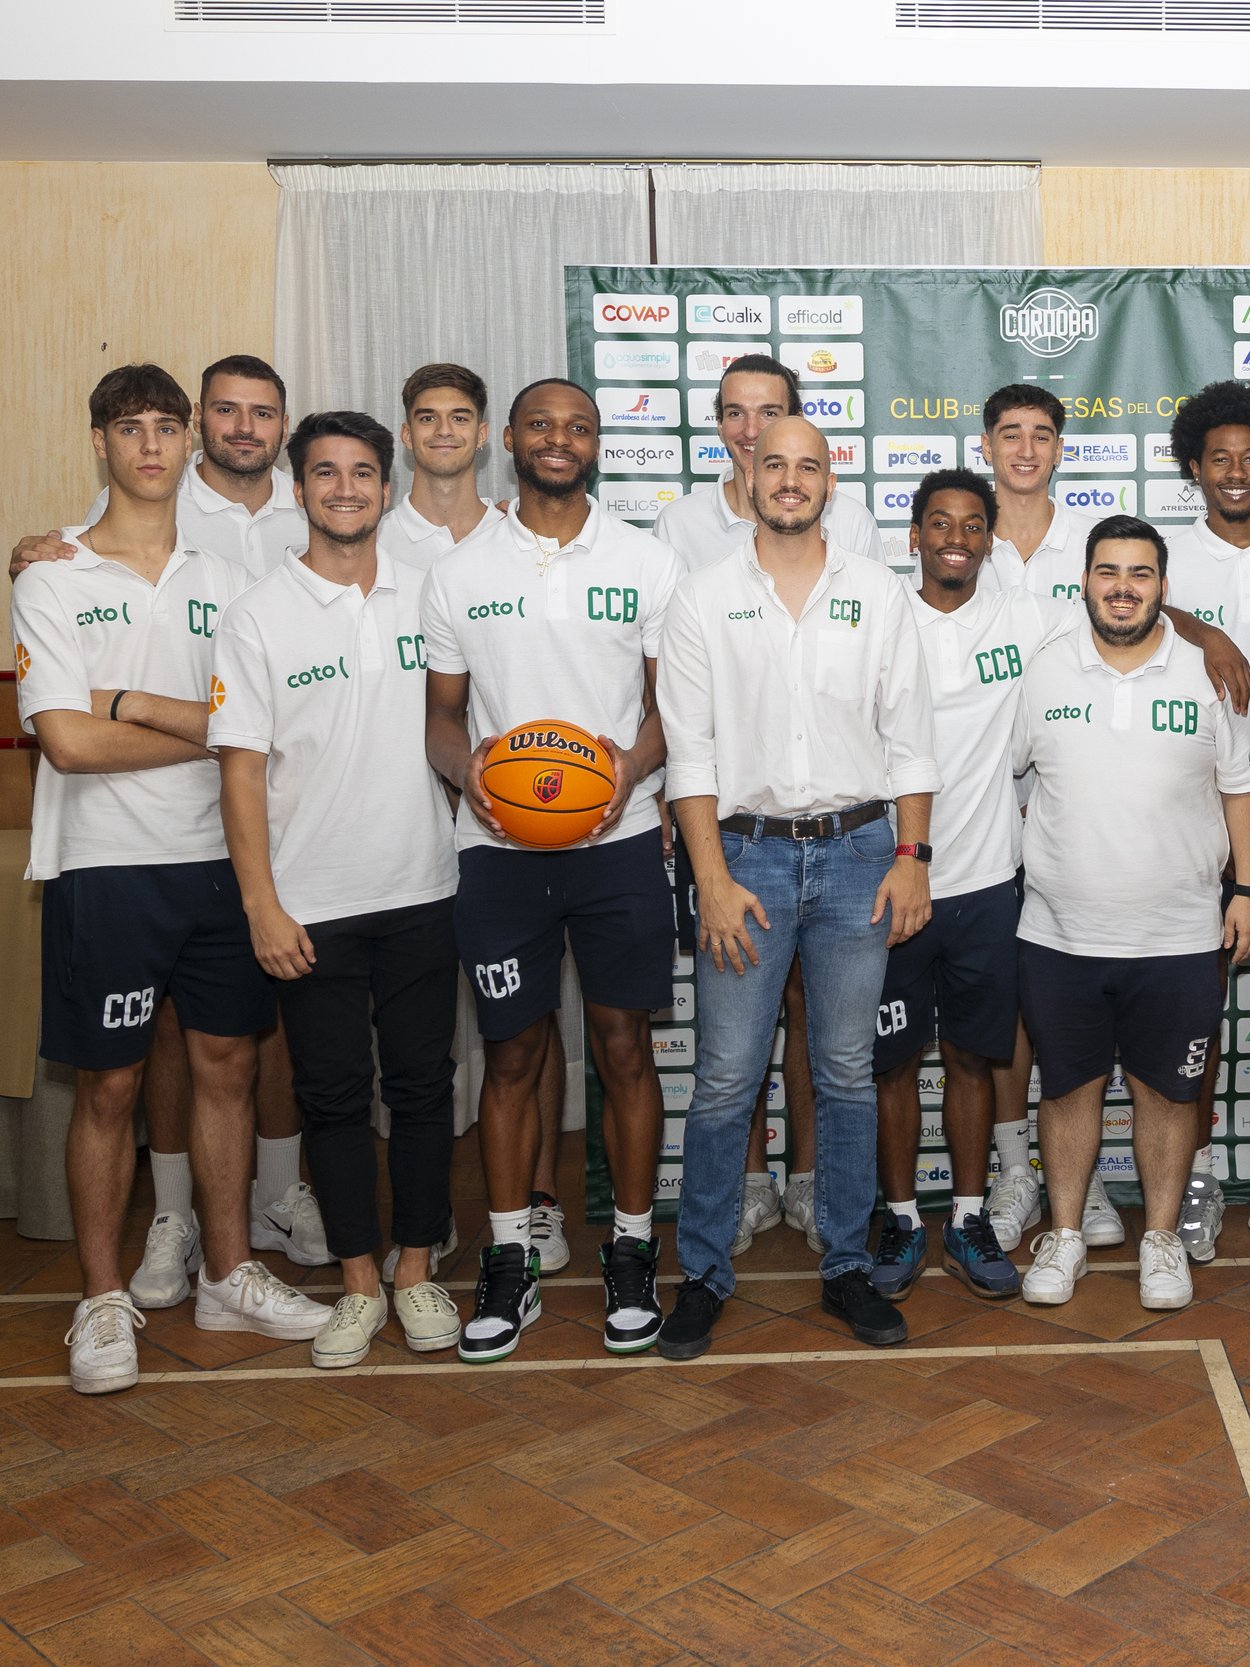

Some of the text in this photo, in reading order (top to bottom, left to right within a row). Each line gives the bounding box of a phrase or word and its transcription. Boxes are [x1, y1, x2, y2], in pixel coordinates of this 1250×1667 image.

[602, 304, 670, 323] COVAP
[713, 305, 762, 323] Cualix
[787, 310, 842, 324] efficold
[611, 413, 640, 421] Cordobesa
[802, 398, 842, 416] oto
[890, 398, 959, 419] CLUB
[963, 404, 981, 416] DE
[1127, 403, 1152, 414] DEL
[1083, 445, 1128, 454] REALE
[884, 491, 915, 508] co
[1065, 489, 1115, 507] coto
[76, 603, 118, 627] coto
[468, 600, 513, 620] coto
[587, 586, 638, 625] CCB
[728, 609, 756, 620] coto
[829, 598, 861, 623] CCB
[188, 599, 218, 638] CC
[397, 635, 428, 671] CC
[976, 644, 1023, 684] CCB
[287, 664, 336, 689] coto
[1045, 704, 1081, 722] coto
[1152, 699, 1199, 736] CCB
[509, 731, 596, 764] Wilson
[476, 957, 521, 1000] CCB
[102, 986, 155, 1029] CCB
[876, 1000, 907, 1037] CB
[1182, 1037, 1210, 1078] CCB
[1098, 1156, 1133, 1165] EALE
